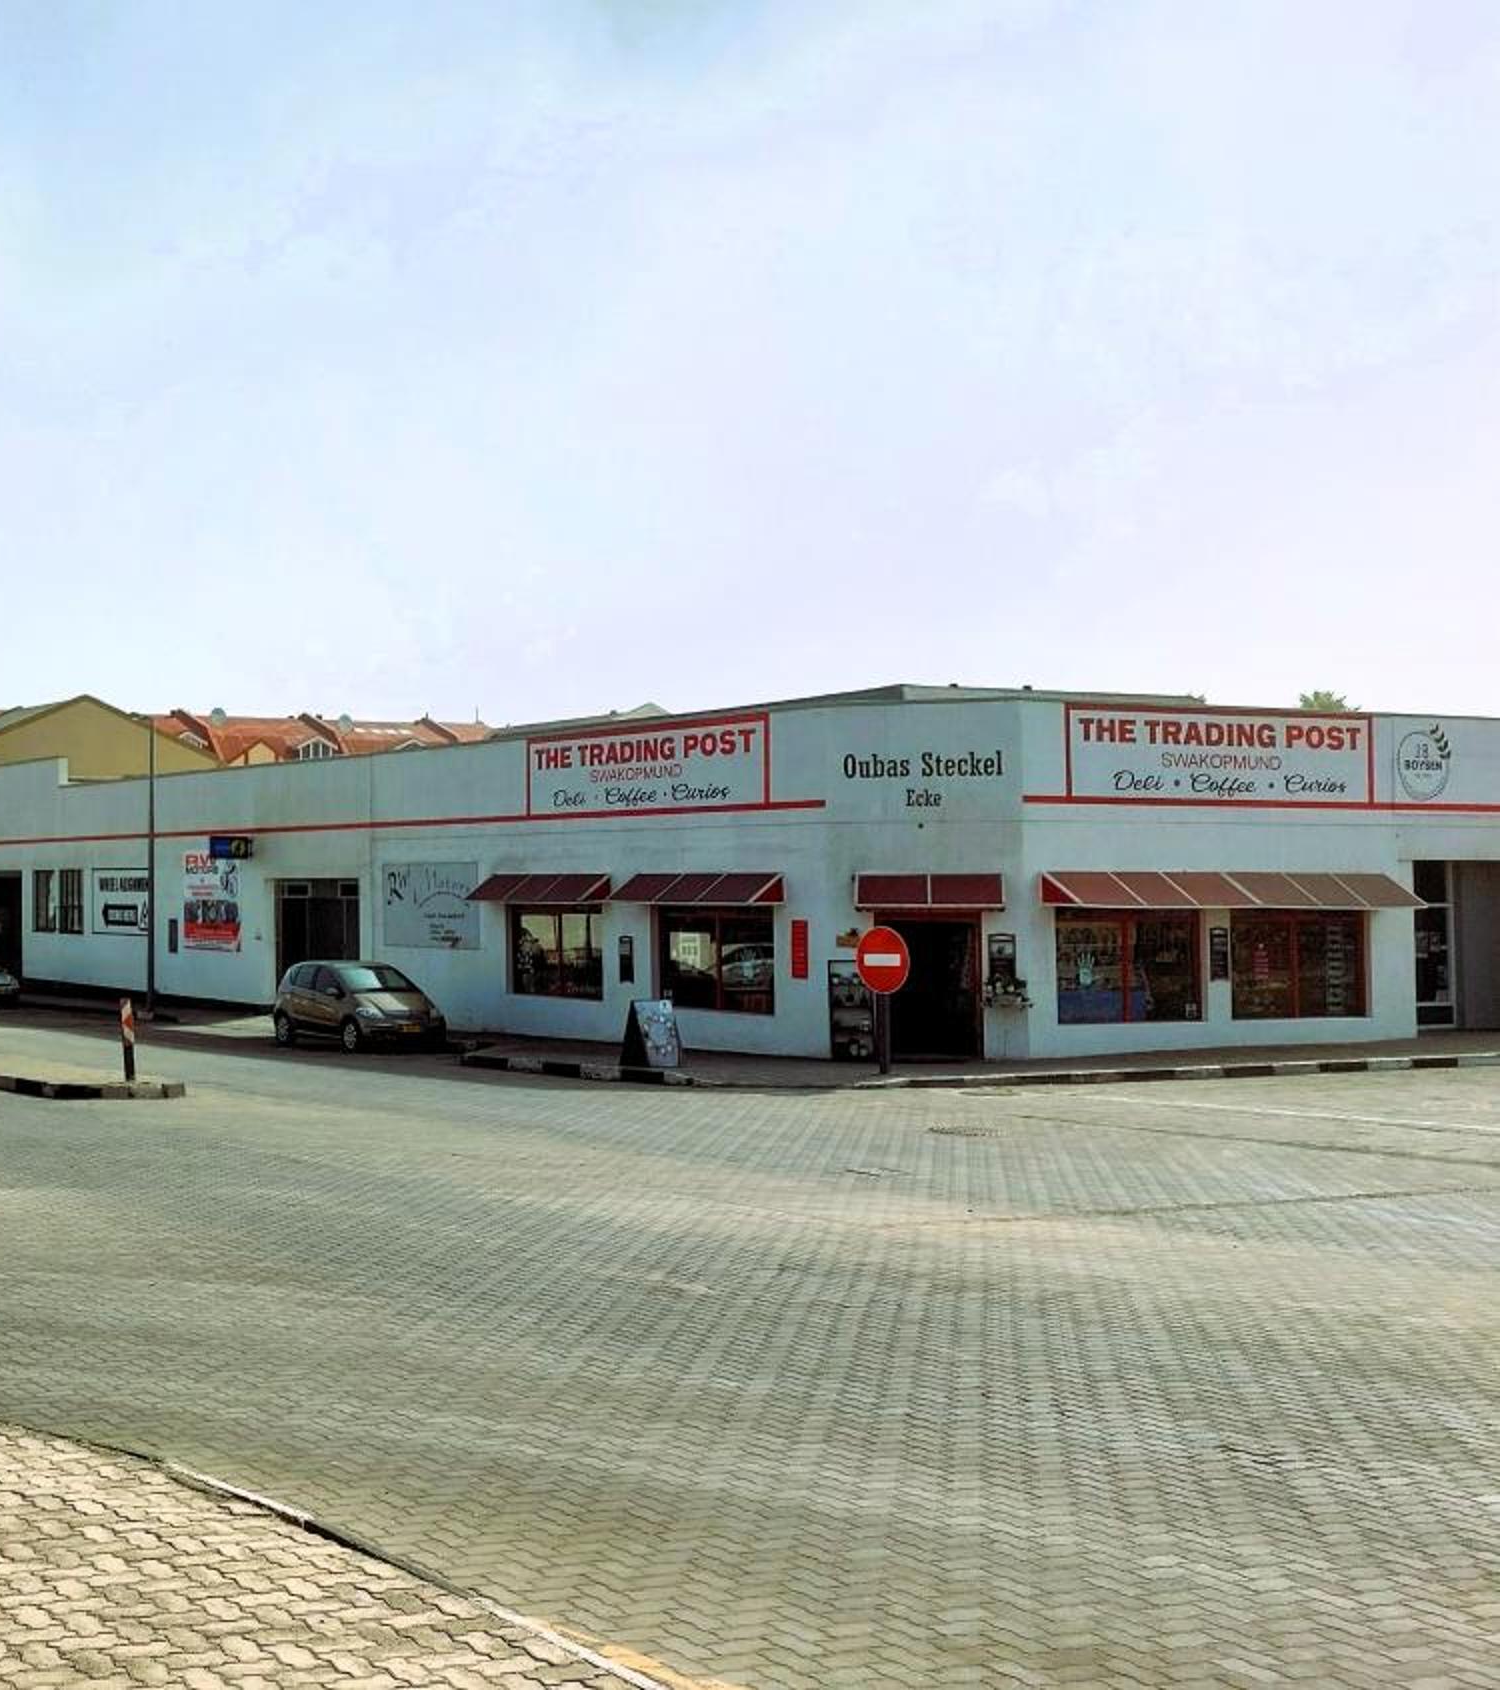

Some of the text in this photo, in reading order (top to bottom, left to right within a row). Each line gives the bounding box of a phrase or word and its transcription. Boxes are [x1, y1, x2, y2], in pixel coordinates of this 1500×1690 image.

[1078, 718, 1361, 751] THE TRADING POST
[534, 728, 757, 770] THE TRADING POST
[1161, 751, 1283, 771] SWAKOPMUND
[589, 763, 683, 783] SWAKOPMUND
[843, 750, 1004, 779] Oubas Steckel
[603, 786, 658, 807] Coffee
[670, 782, 731, 801] Curios
[1113, 770, 1347, 798] Deli Coffee Curios
[905, 788, 942, 807] Ecke
